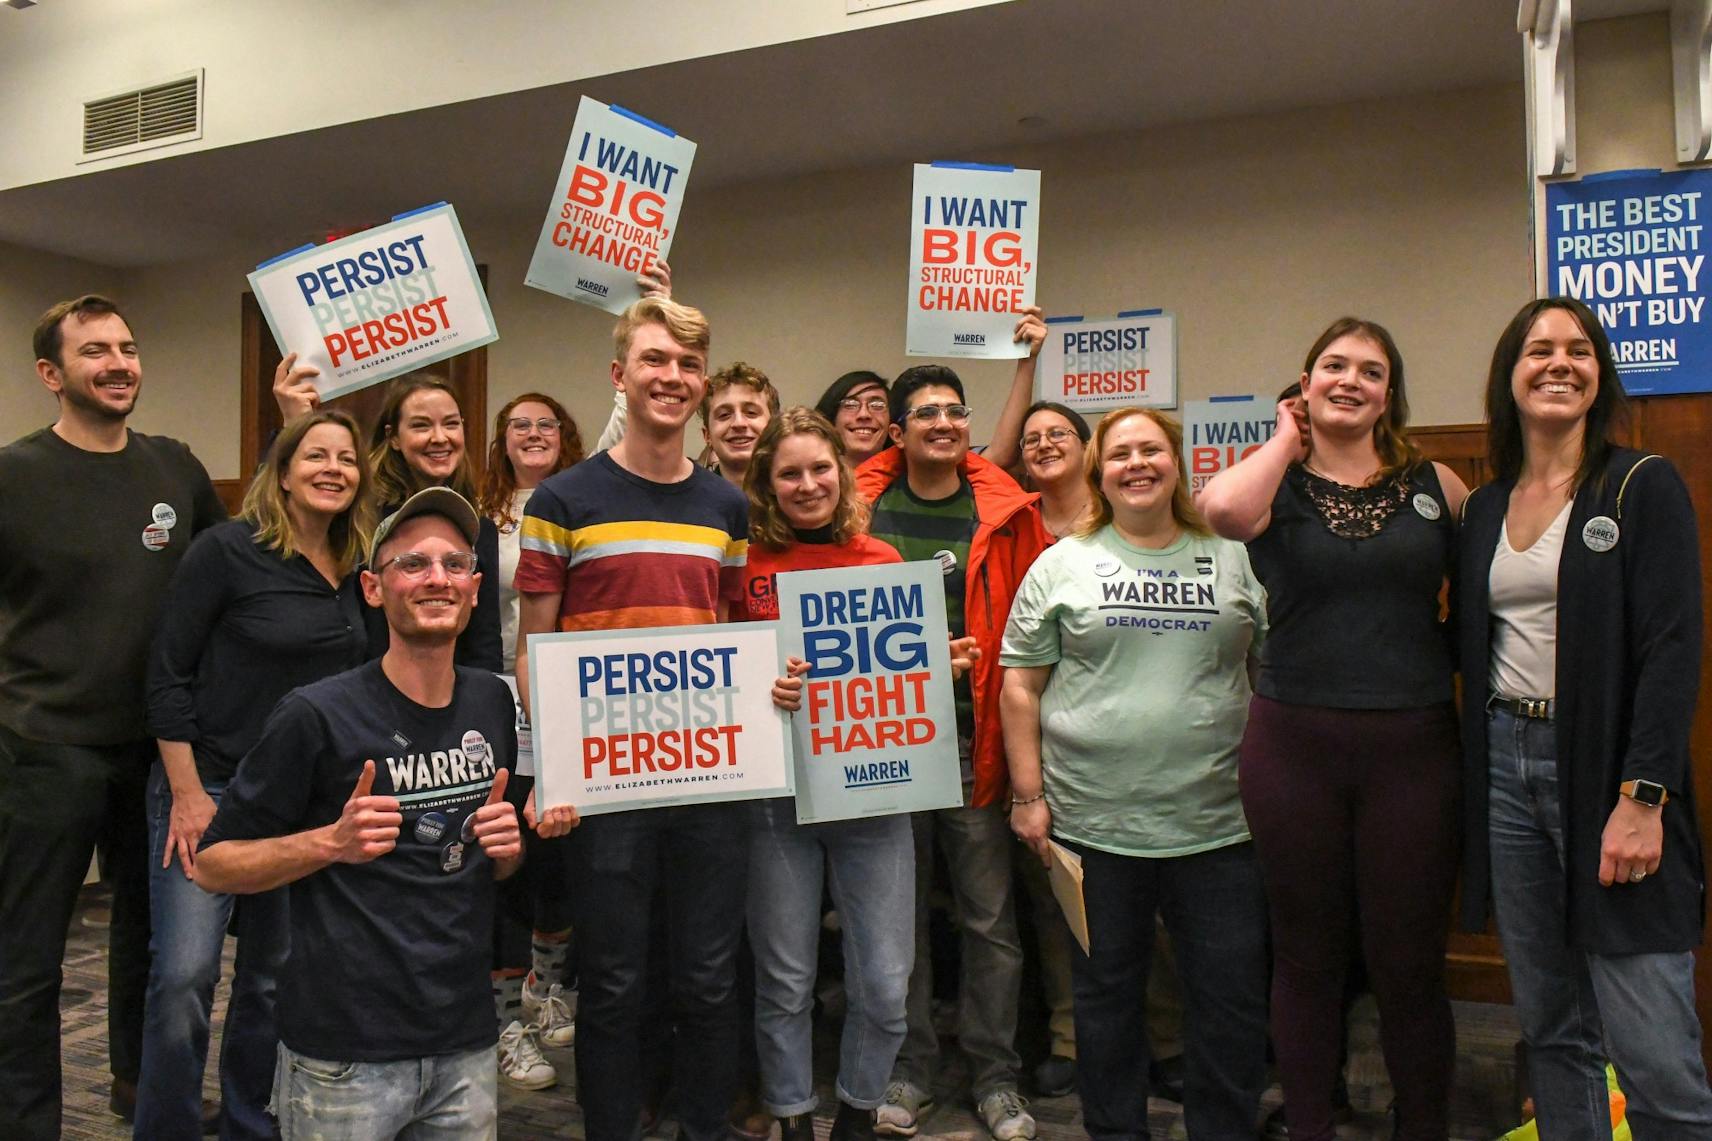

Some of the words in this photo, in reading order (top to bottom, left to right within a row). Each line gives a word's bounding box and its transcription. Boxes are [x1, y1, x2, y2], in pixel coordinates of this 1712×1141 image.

[578, 132, 591, 161] I
[597, 138, 678, 194] WANT
[567, 164, 669, 240] BIG,
[924, 196, 931, 224] I
[941, 197, 1027, 229] WANT
[1556, 200, 1616, 231] THE
[1624, 192, 1702, 226] BEST
[560, 203, 660, 251] STRUCTURAL
[1558, 225, 1703, 261] PRESIDENT
[553, 222, 658, 276] CHANGE
[922, 229, 1031, 274] BIG,
[296, 235, 429, 306] PERSIST
[577, 277, 608, 295] WARREN
[921, 267, 1024, 286] STRUCTURAL
[1558, 255, 1705, 300] MONEY
[310, 266, 439, 337] PERSIST
[920, 285, 1024, 314] CHANGE
[1586, 301, 1642, 328] N'T
[1648, 297, 1705, 326] BUY
[323, 296, 451, 368] PERSIST
[954, 333, 985, 343] WARREN
[1064, 327, 1150, 354] PERSIST
[1609, 338, 1676, 362] ARREN
[1064, 369, 1150, 396] PERSIST
[1193, 424, 1198, 445] I
[1205, 420, 1275, 445] WANT
[1587, 527, 1615, 540] WARREN
[1137, 569, 1163, 578] I'M
[1168, 570, 1179, 578] A
[800, 584, 924, 627] DREAM
[1102, 582, 1215, 606] WARREN
[1106, 616, 1211, 632] DEMOCRAT
[803, 622, 928, 679] BIG
[578, 646, 738, 697] PERSIST
[580, 686, 740, 737] PERSIST
[807, 672, 931, 725] FIGHT
[466, 744, 485, 752] WARREN
[582, 725, 742, 779] PERSIST
[811, 718, 936, 755] HARD
[585, 772, 745, 793] WWW.ELIZABETHWARREN.COM
[844, 759, 910, 783] WARREN
[417, 824, 442, 837] WARREN
